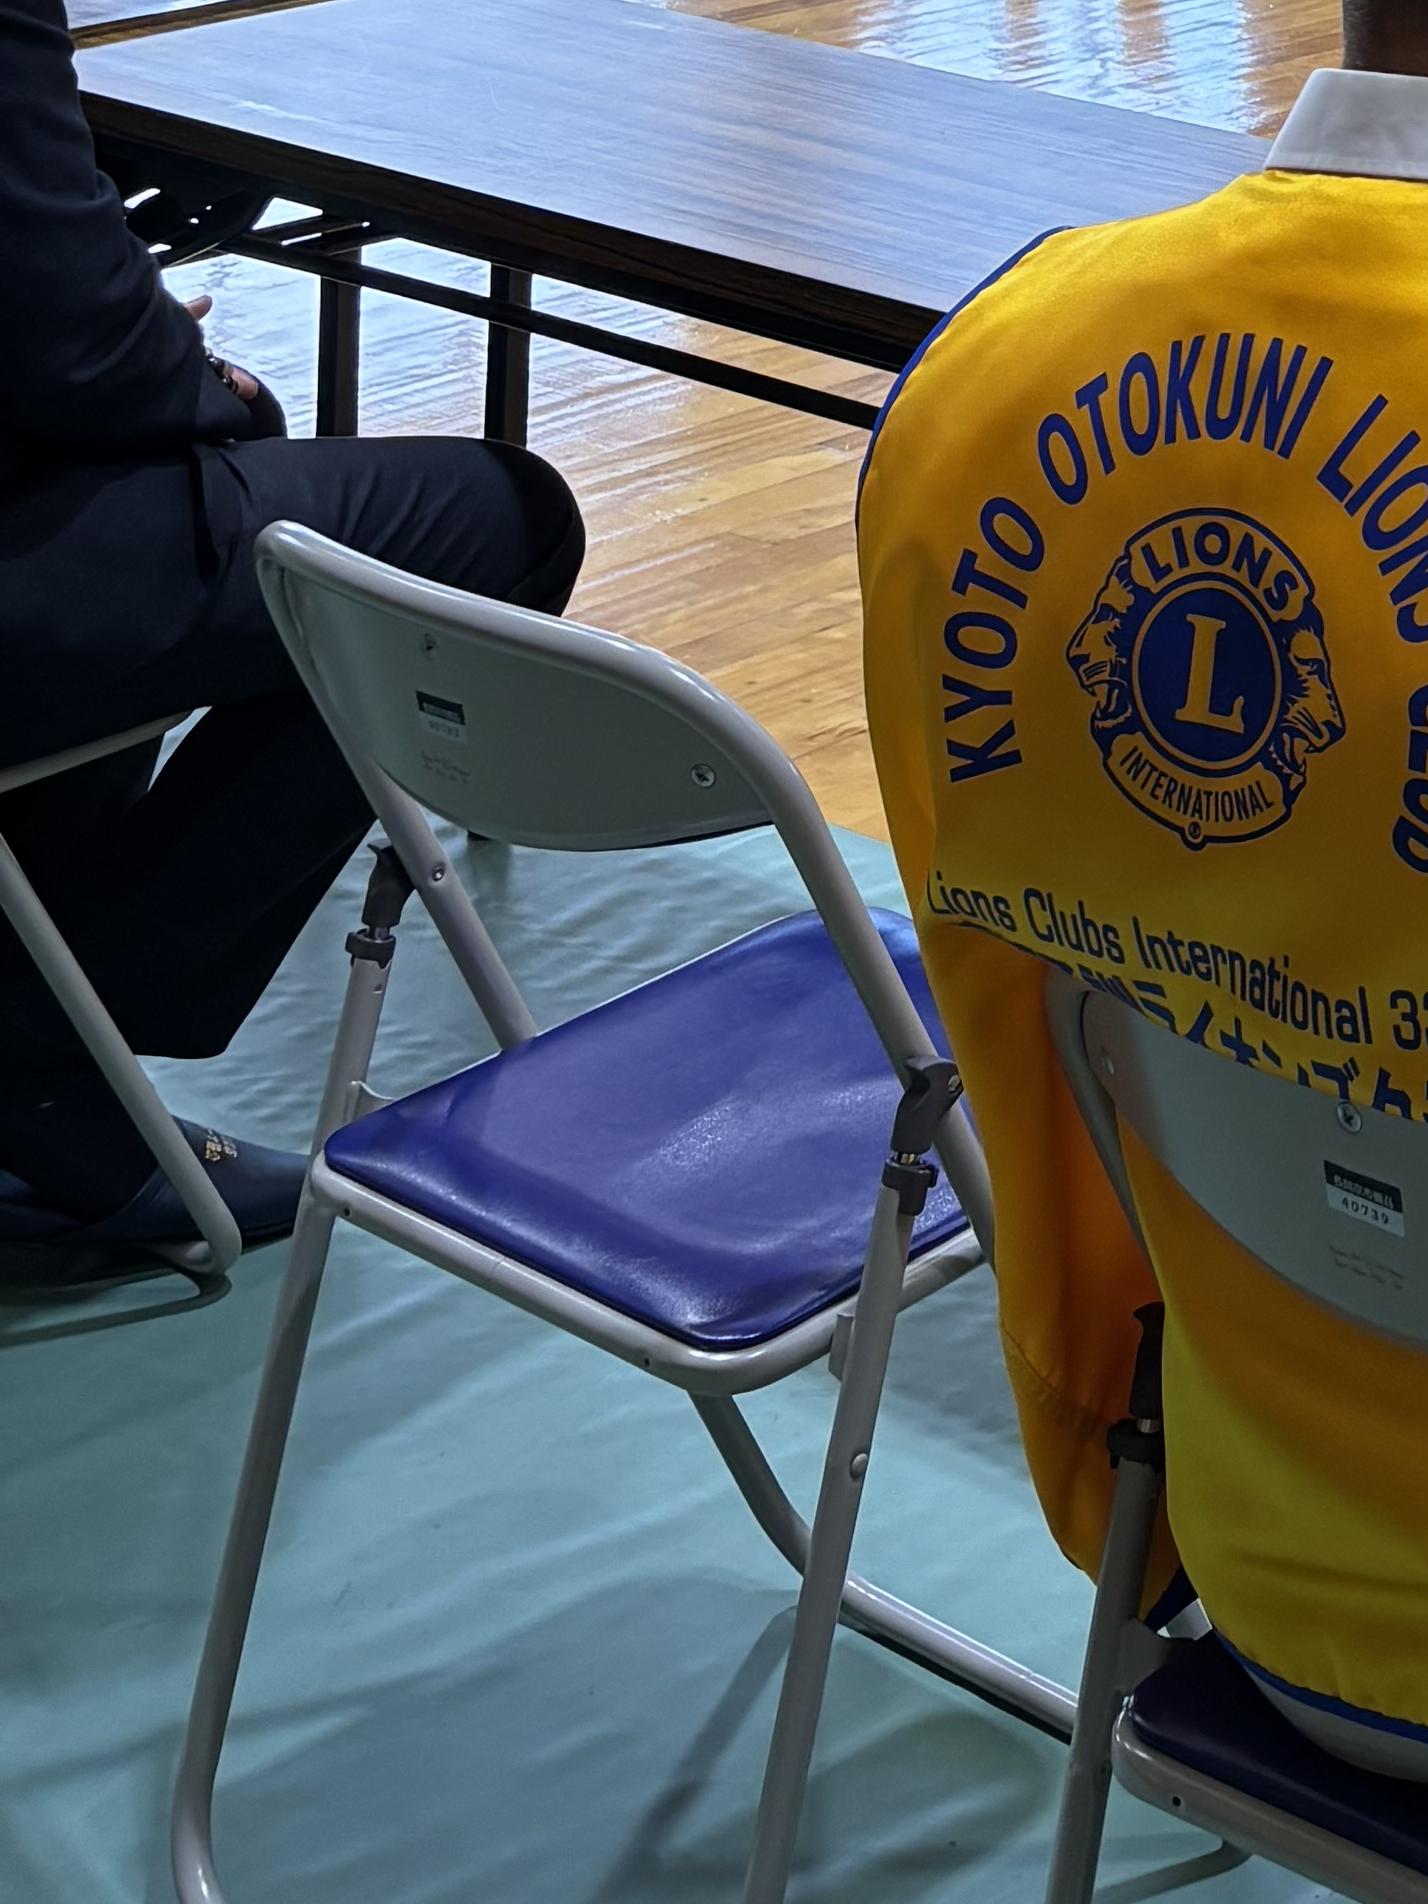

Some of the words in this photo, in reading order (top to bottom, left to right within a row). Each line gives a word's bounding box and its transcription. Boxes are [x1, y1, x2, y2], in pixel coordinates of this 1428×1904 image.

[942, 496, 1046, 785] KYOTO
[1036, 332, 1335, 507] OTOKUNI
[1140, 526, 1303, 617] LIONS
[1174, 611, 1248, 737] L
[1119, 744, 1275, 824] INTERNATIONAL
[926, 869, 1017, 933] Lions
[1023, 886, 1127, 966] Clubs
[1131, 915, 1374, 1045] International
